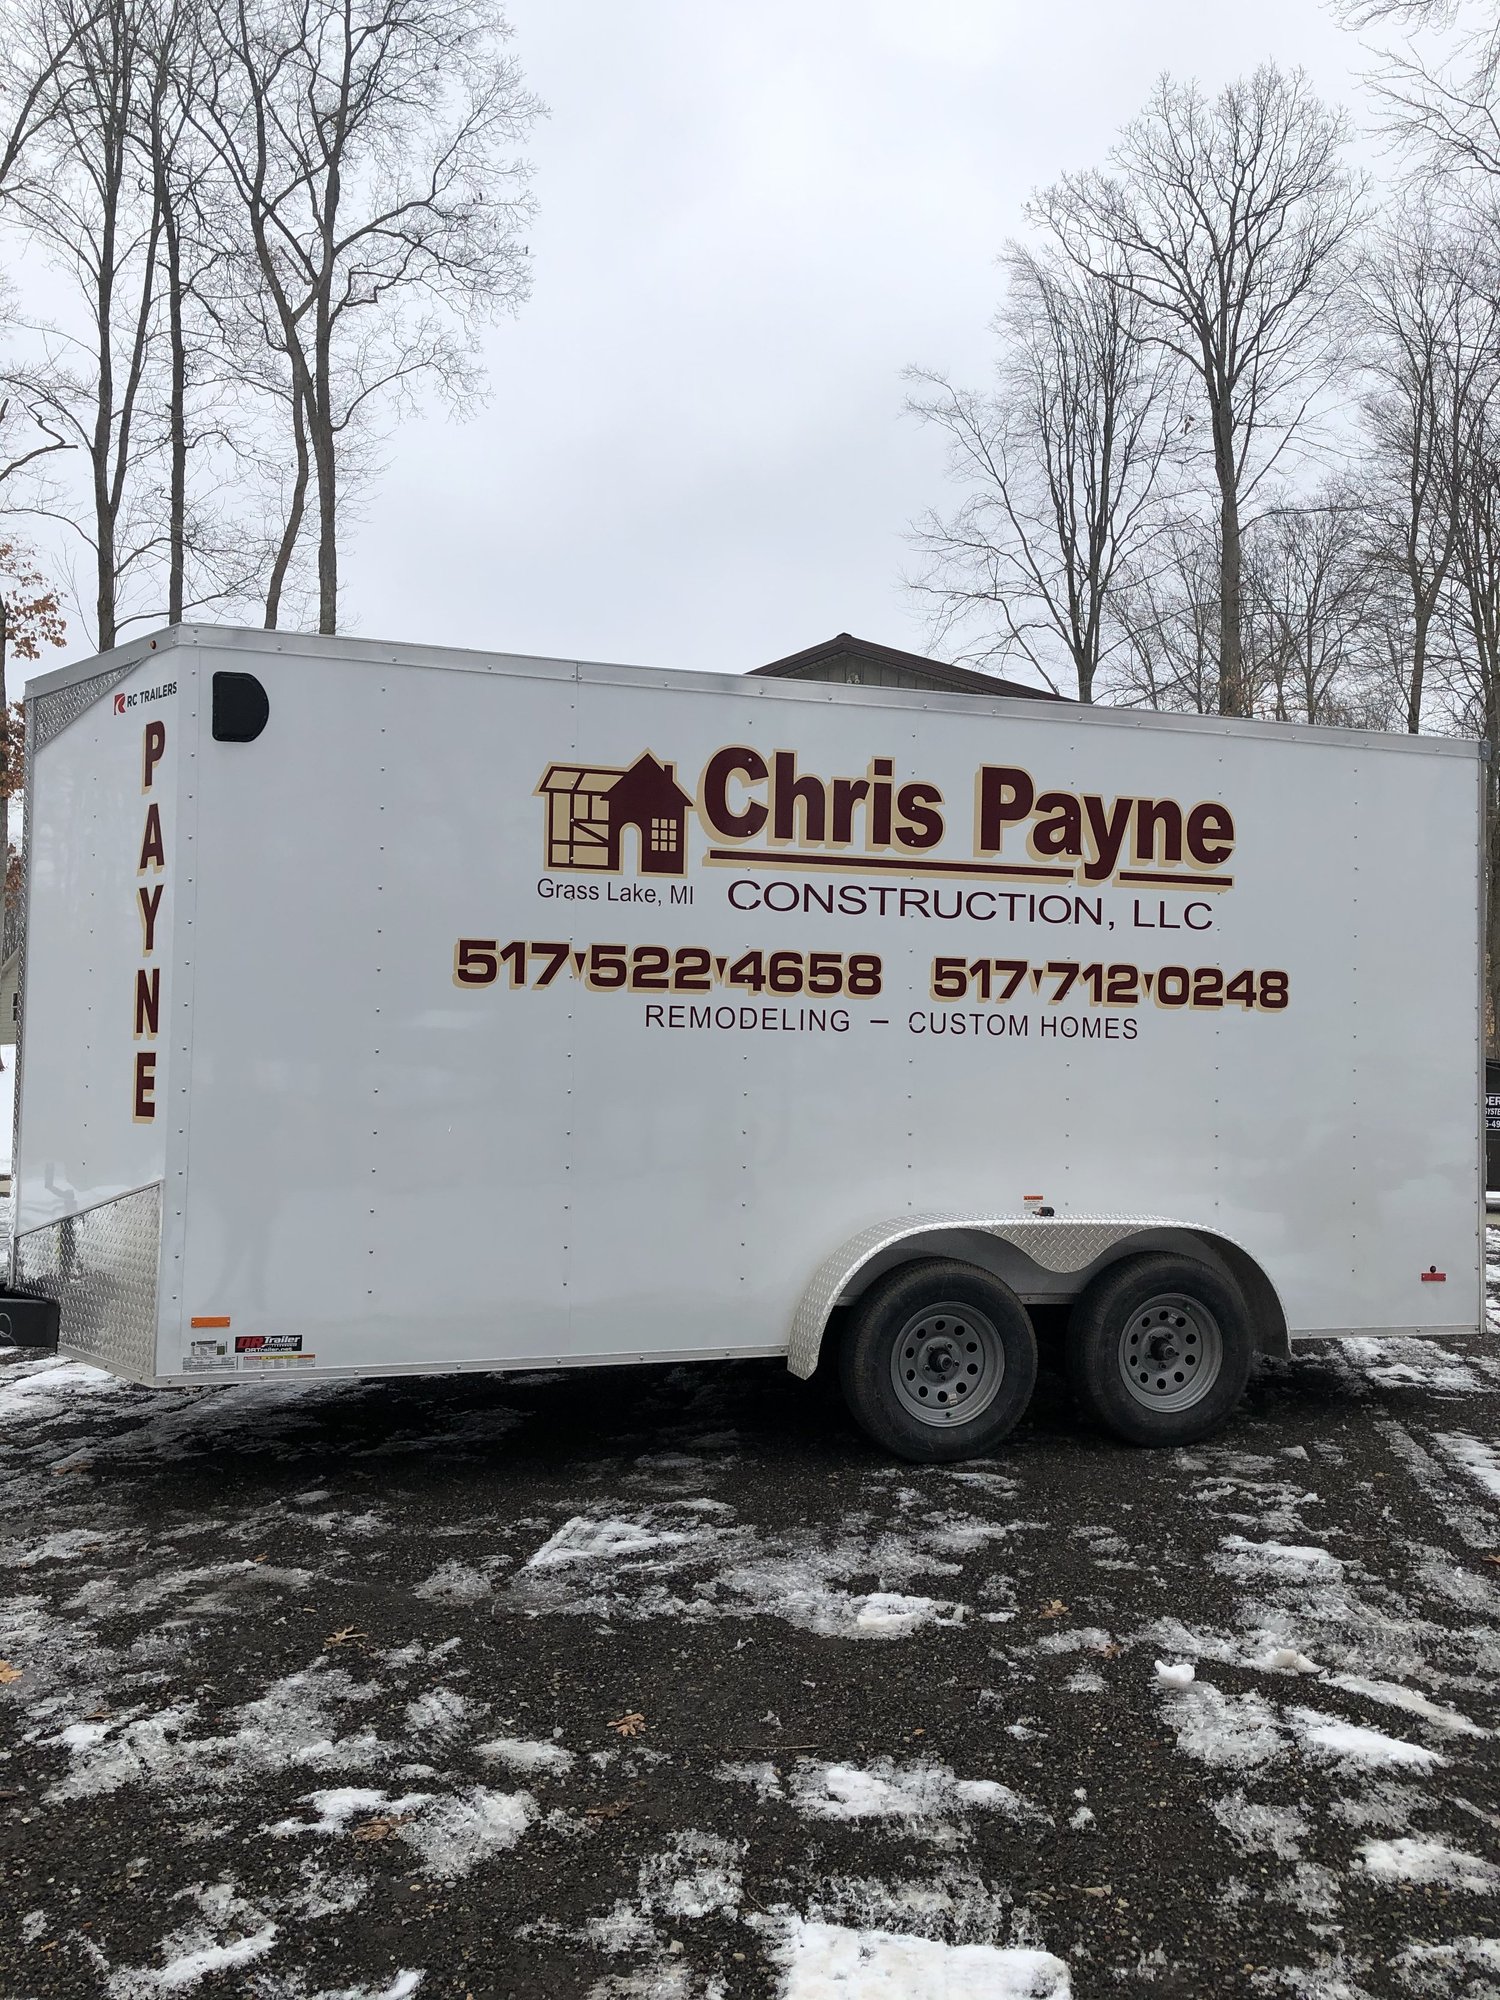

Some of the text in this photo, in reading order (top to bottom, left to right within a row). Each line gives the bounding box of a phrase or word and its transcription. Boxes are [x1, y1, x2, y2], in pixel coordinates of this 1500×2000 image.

[126, 681, 178, 707] RC TRAILERS
[700, 745, 1236, 882] Chris Payne
[537, 877, 694, 907] Grass Lake, MI
[727, 879, 1213, 931] CONSTRUCTION, LLC
[133, 720, 167, 1123] PAYNE
[645, 1004, 850, 1034] REMODELING
[908, 1011, 1030, 1038] CUSTOM
[1040, 1015, 1139, 1040] HOMES
[264, 1335, 301, 1344] Trailer
